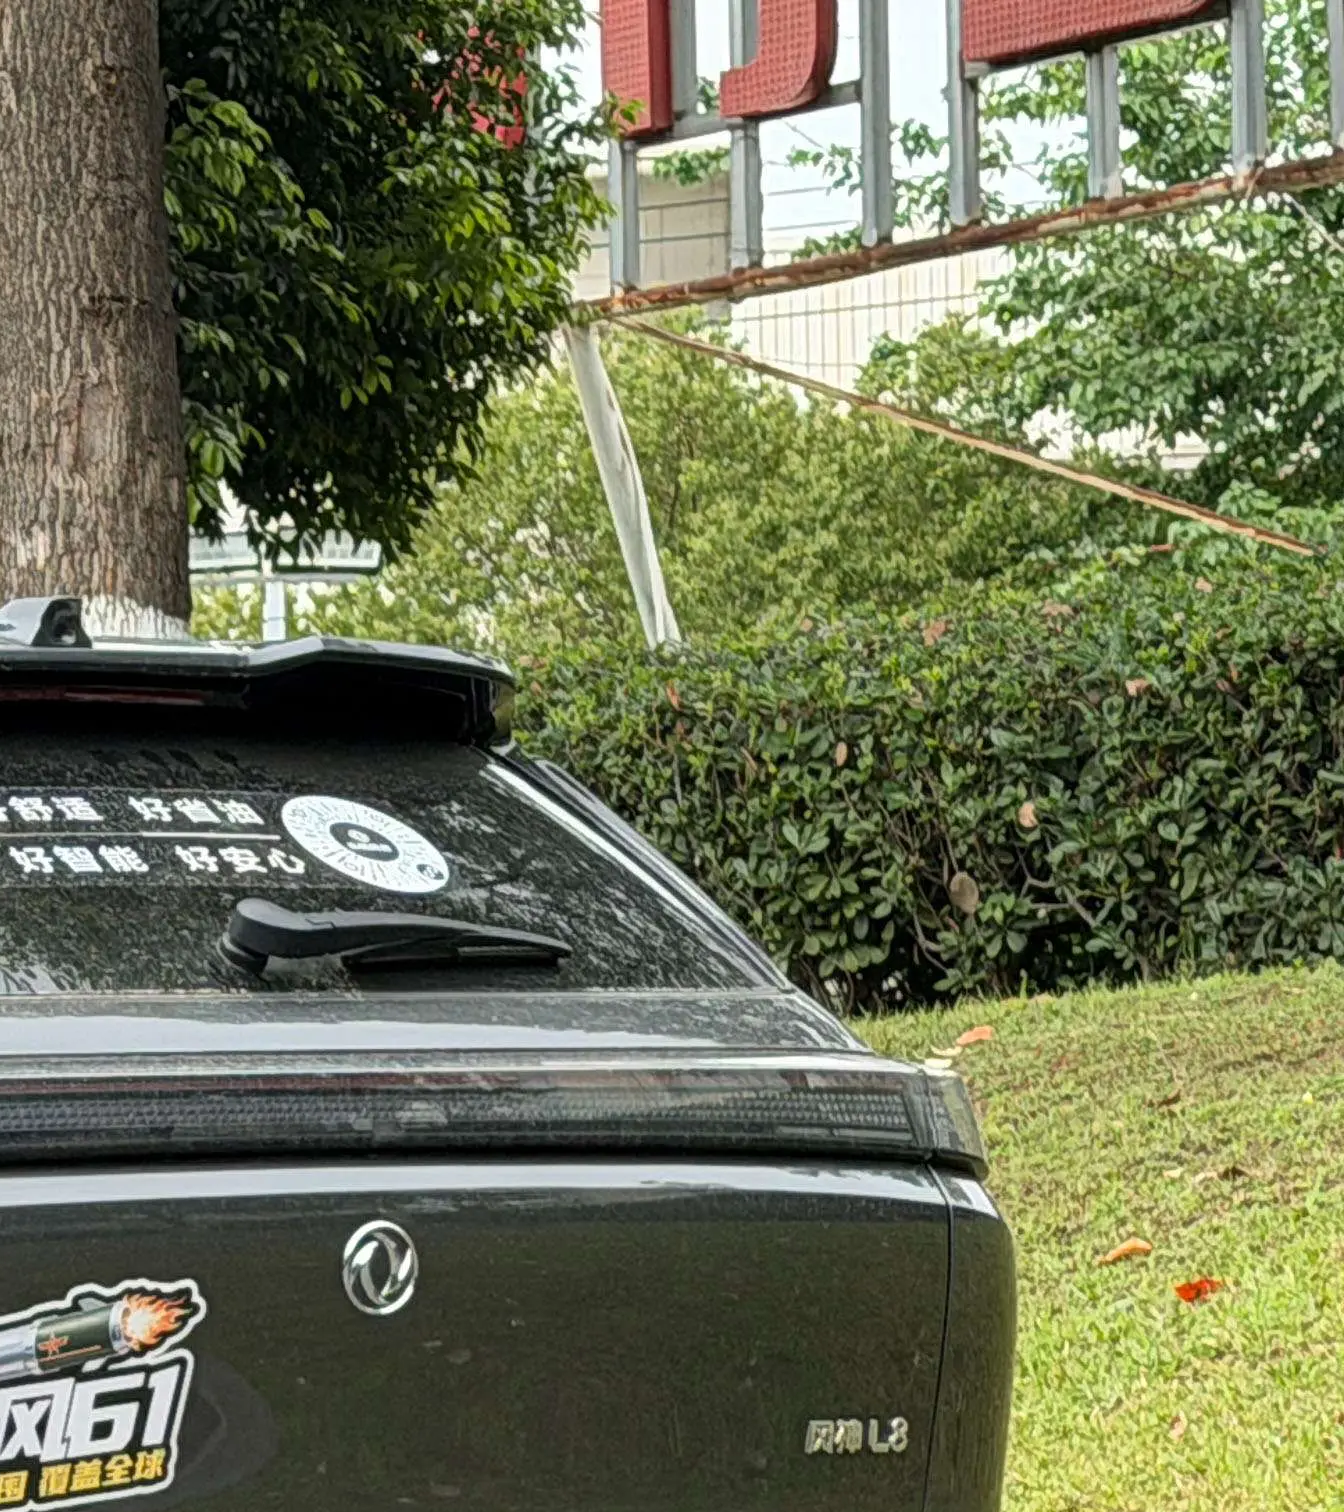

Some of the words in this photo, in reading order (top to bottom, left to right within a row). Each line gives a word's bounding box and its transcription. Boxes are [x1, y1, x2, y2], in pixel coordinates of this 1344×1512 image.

[128, 796, 265, 824] 好省油
[10, 845, 150, 873] 好智能
[175, 844, 306, 875] 好安心
[38, 1447, 166, 1498] 覆盖全球
